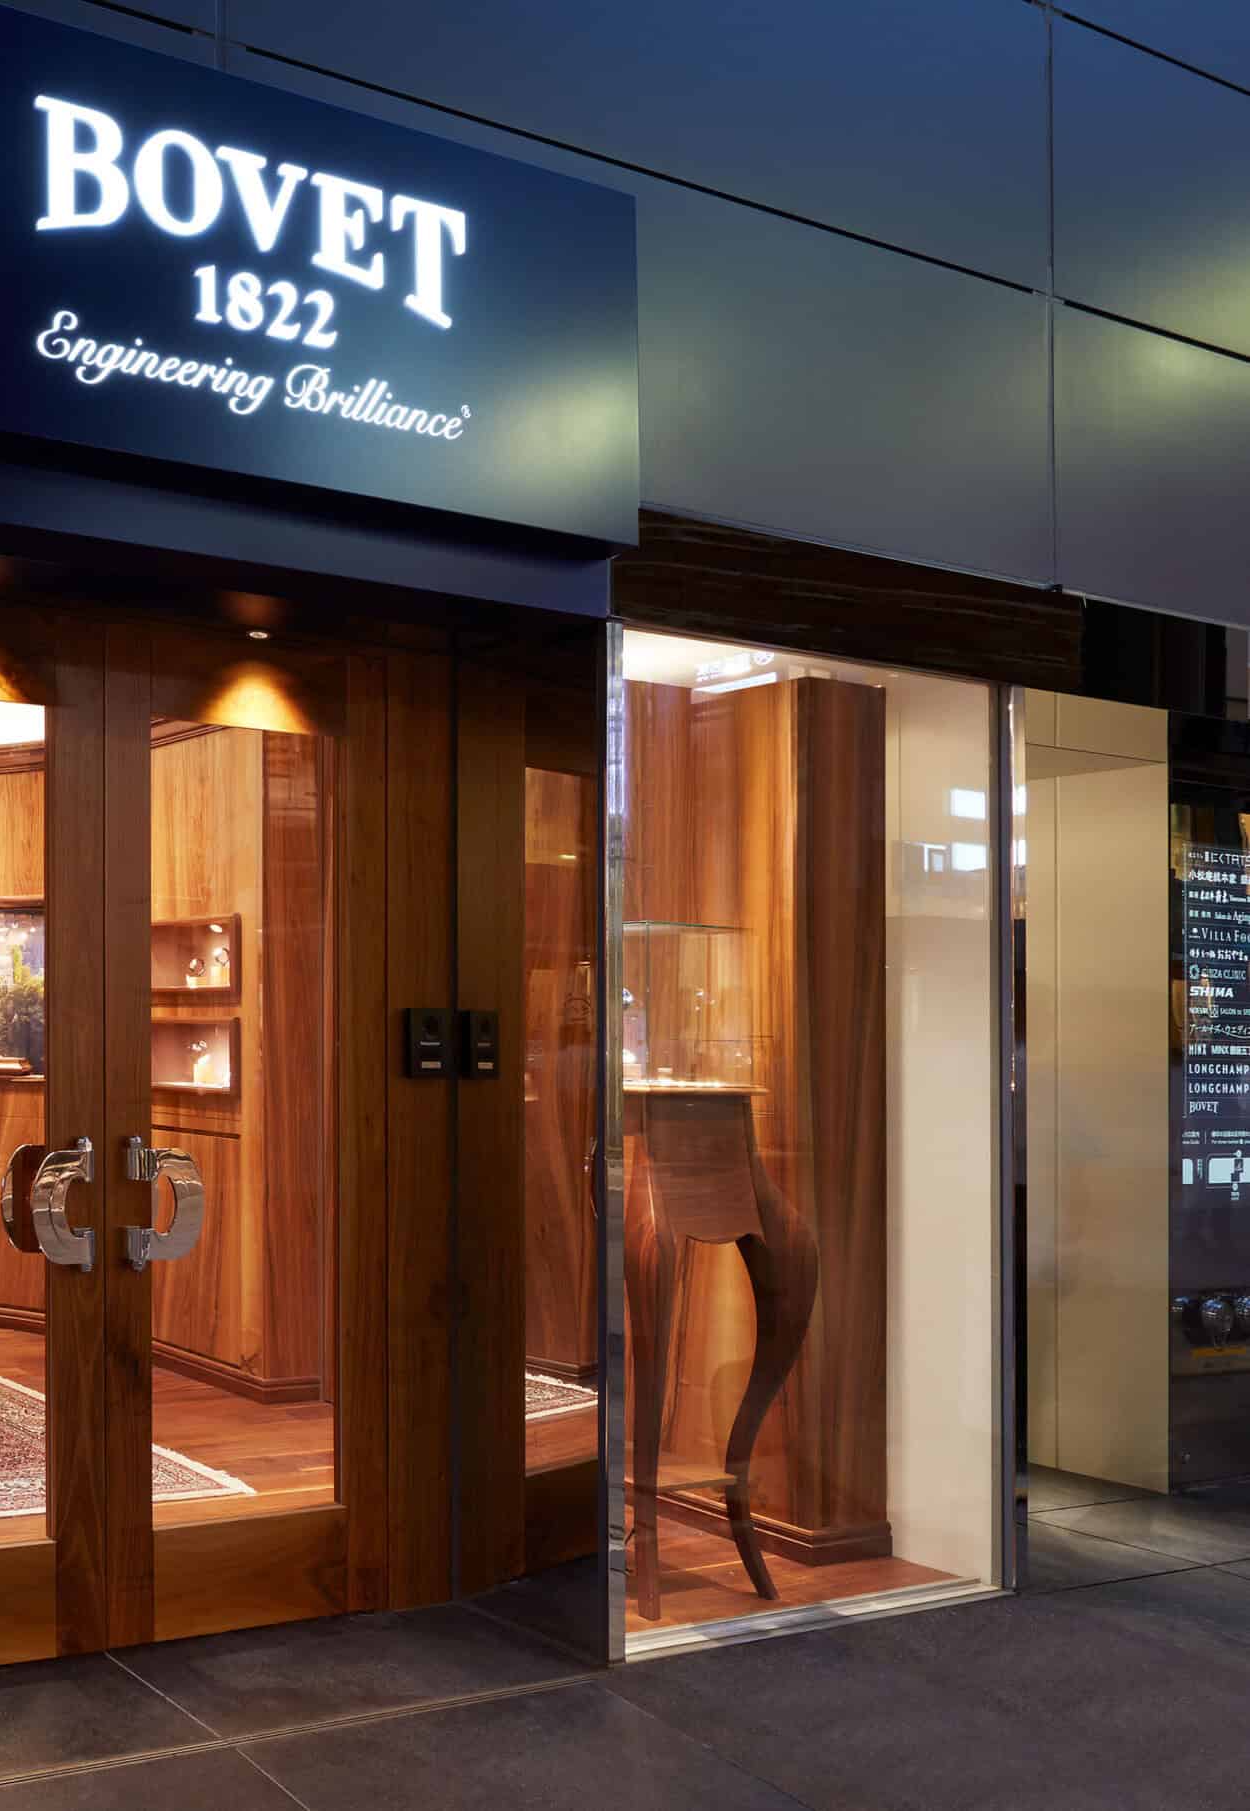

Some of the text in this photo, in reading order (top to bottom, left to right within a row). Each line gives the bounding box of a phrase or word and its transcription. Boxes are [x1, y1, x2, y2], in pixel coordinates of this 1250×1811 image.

[34, 95, 465, 328] BOVET
[194, 265, 338, 348] 1822
[36, 310, 275, 415] Engineering
[1201, 927, 1231, 942] VILLA
[1189, 985, 1234, 998] SHIMA
[1188, 1063, 1250, 1075] LONGCHAMP
[1188, 1083, 1250, 1094] LONGCHAMP
[1189, 1101, 1219, 1114] BOVET
